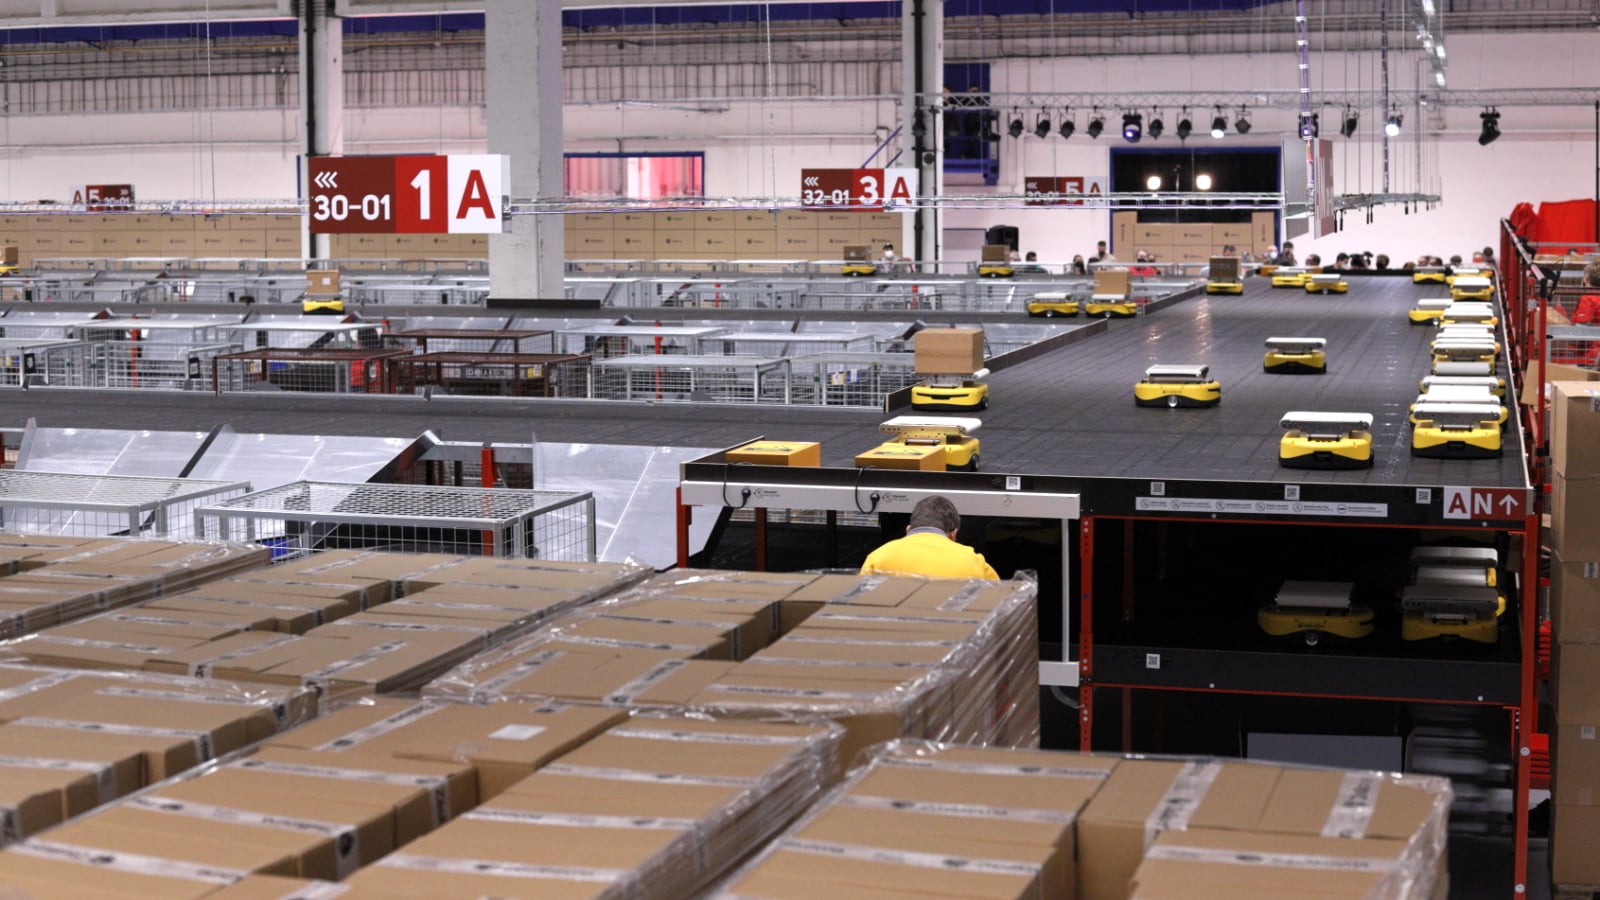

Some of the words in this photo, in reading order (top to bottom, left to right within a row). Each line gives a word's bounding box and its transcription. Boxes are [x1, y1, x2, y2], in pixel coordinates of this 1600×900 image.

[313, 194, 391, 221] 30-01
[410, 169, 431, 220] 1
[456, 169, 496, 219] A
[803, 189, 850, 205] 32-01
[860, 175, 879, 205] 3
[890, 176, 913, 204] A
[1065, 181, 1080, 202] 5
[1088, 182, 1103, 202] A
